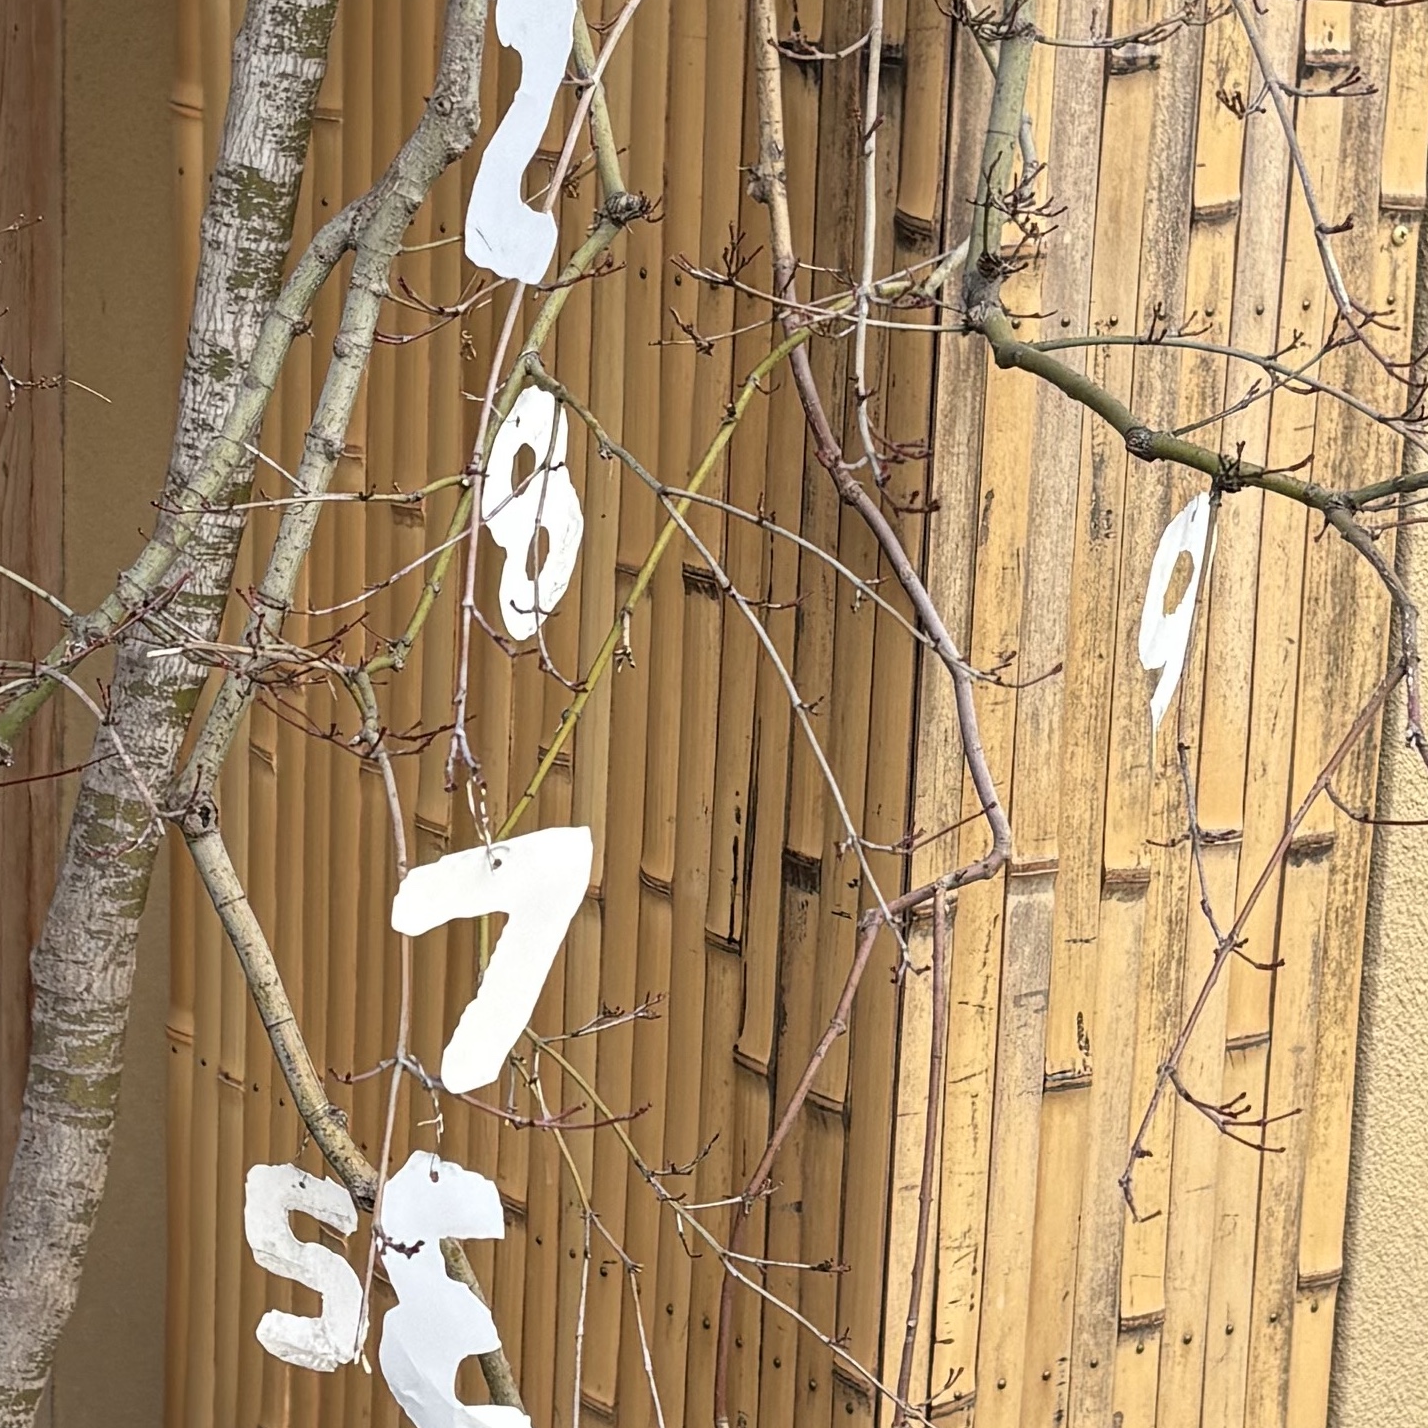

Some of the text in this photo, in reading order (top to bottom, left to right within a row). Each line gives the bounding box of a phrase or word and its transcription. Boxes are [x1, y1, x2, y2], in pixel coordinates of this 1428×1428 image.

[481, 386, 584, 641] 8
[391, 826, 593, 1093] 7
[245, 1163, 369, 1372] 5
